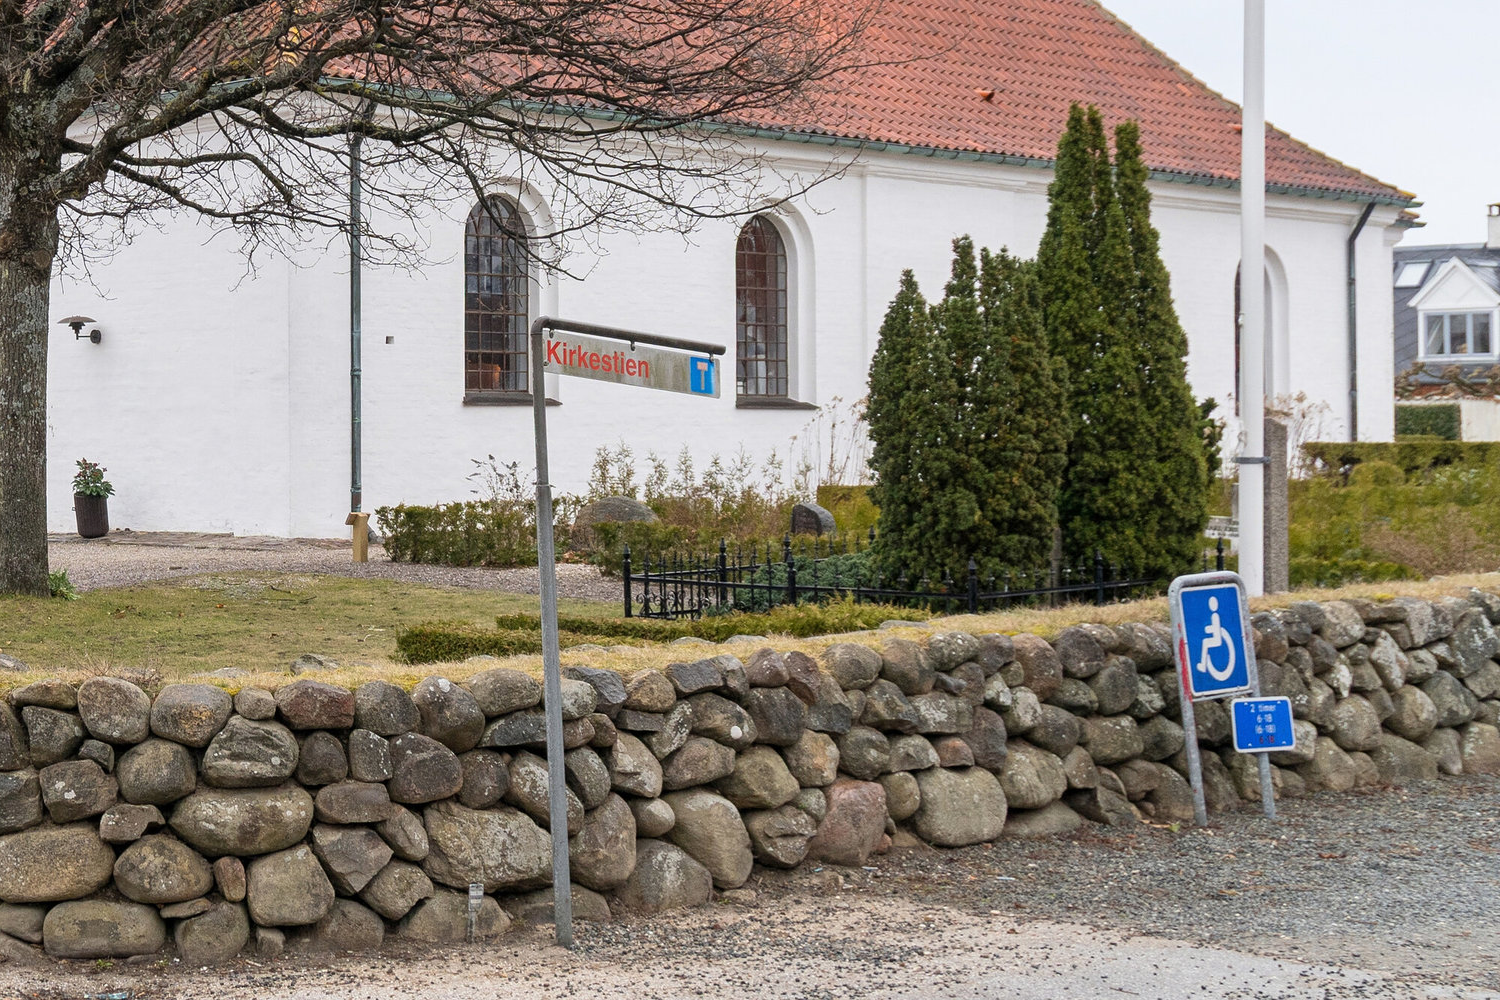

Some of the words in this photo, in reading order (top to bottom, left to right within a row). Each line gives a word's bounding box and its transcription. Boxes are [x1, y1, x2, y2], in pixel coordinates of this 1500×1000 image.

[546, 340, 650, 378] Kirkestien
[1250, 704, 1255, 713] 2
[1258, 704, 1276, 712] timer
[1257, 713, 1272, 723] 6-18
